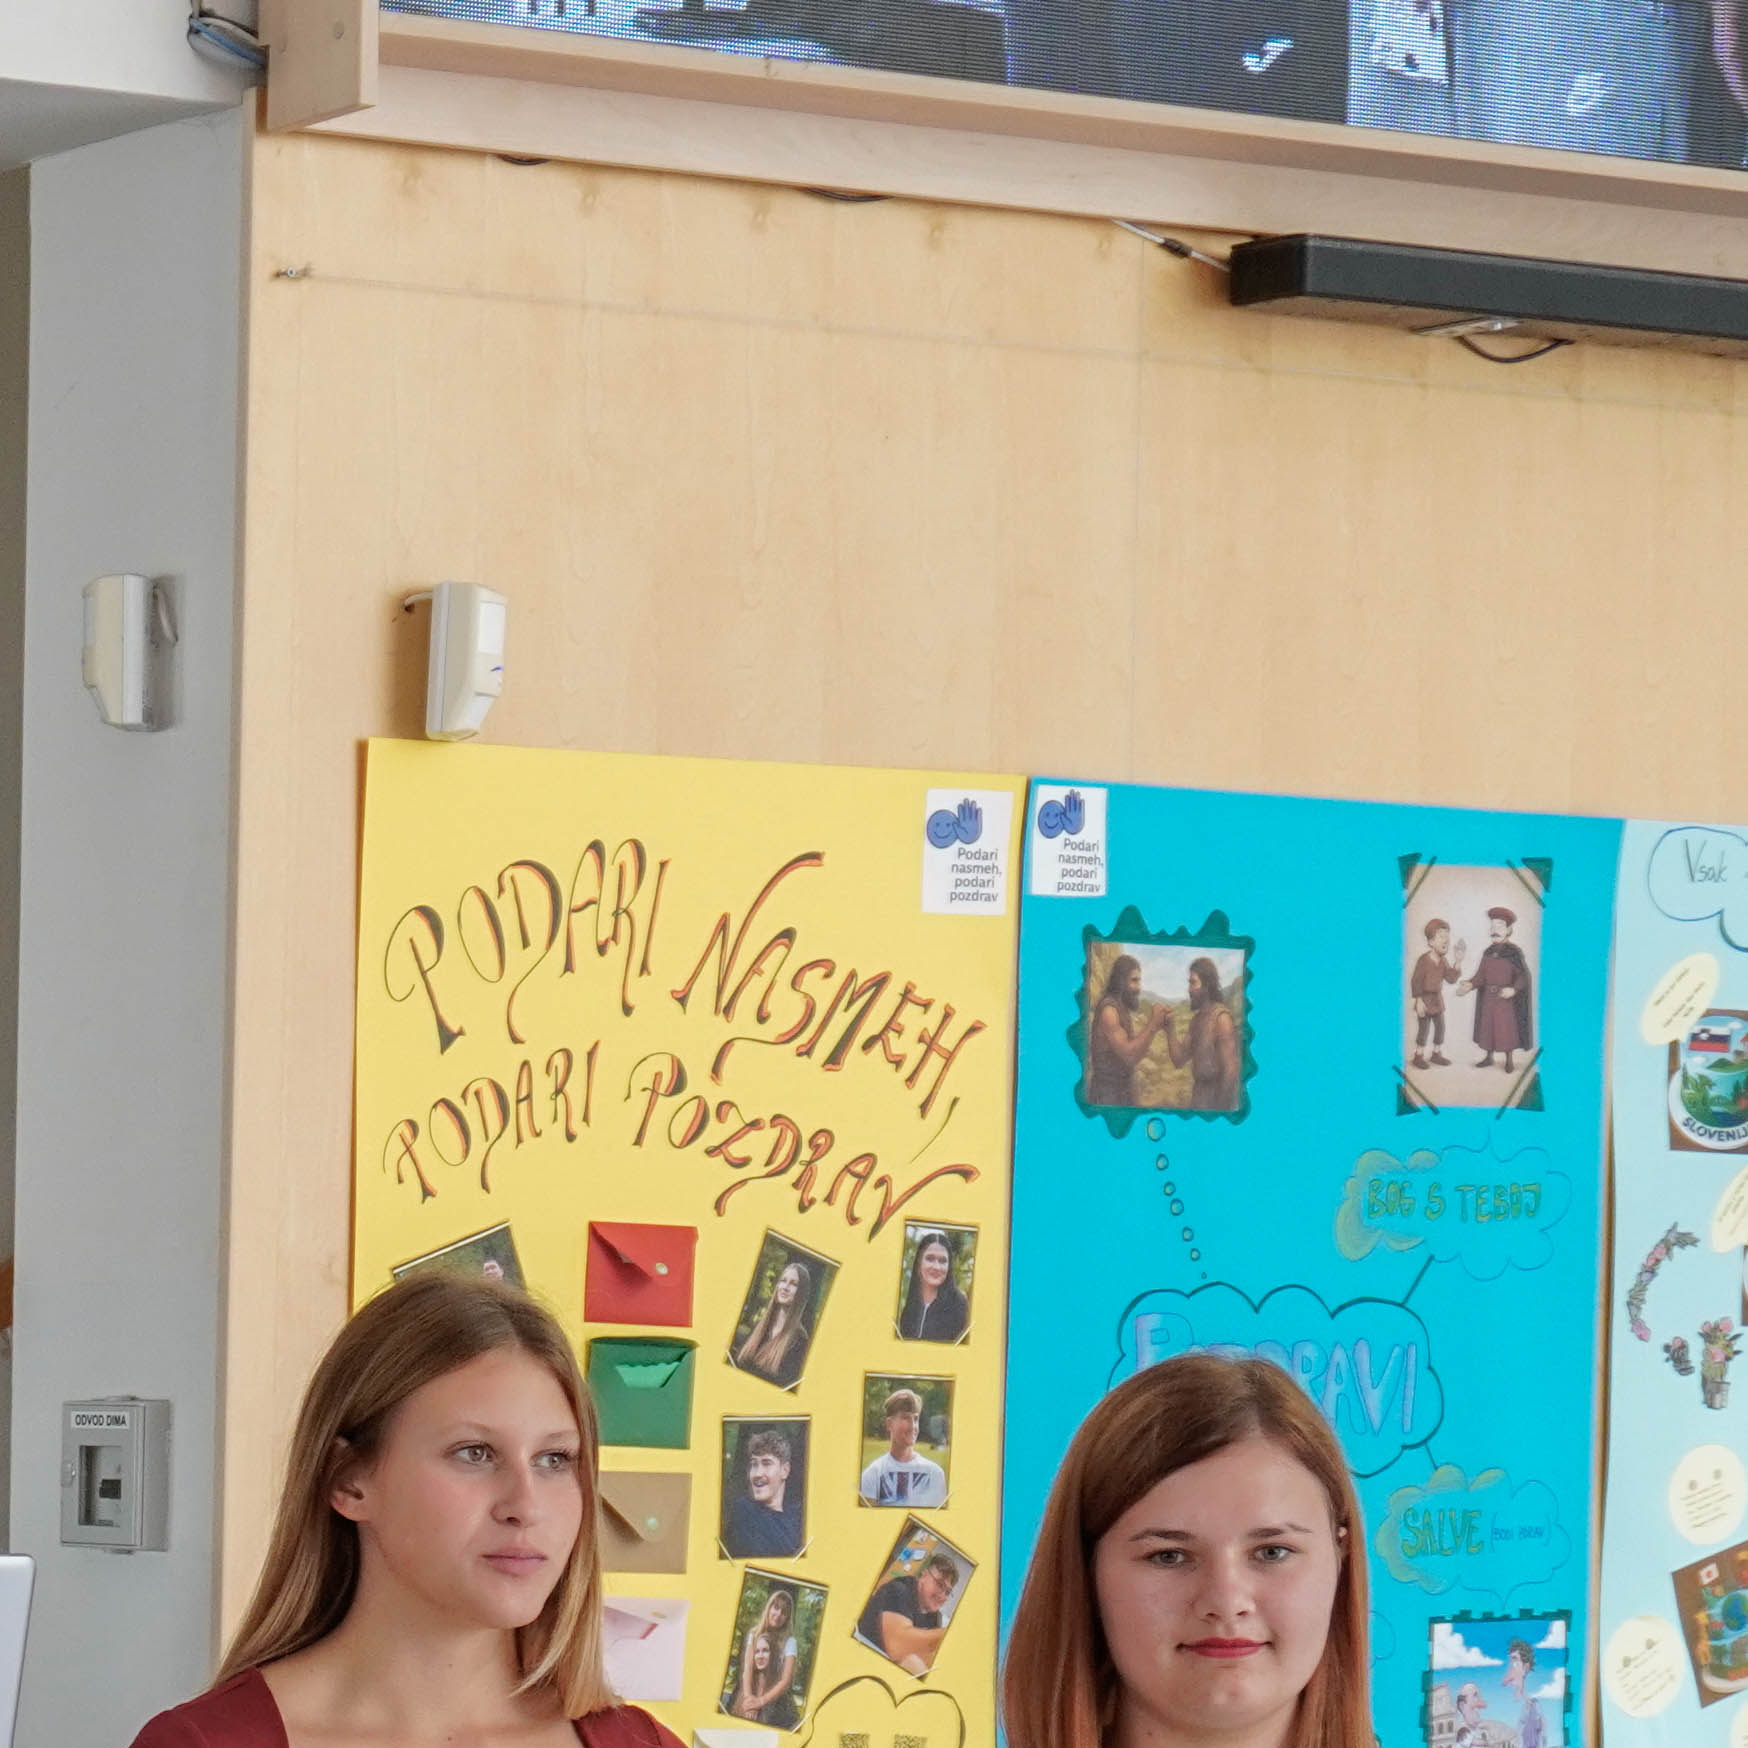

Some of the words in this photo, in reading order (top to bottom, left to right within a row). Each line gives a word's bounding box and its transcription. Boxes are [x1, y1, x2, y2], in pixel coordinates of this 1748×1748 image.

[1063, 837, 1100, 851] Podari
[958, 847, 998, 861] Podari
[1058, 852, 1104, 867] nasmeh,
[951, 863, 1002, 876] nasmeh,
[1061, 867, 1098, 881] podari
[955, 876, 995, 890] podari
[1057, 881, 1101, 893] pozdrav
[950, 890, 999, 904] pozdrav
[385, 838, 671, 1055] PODARI
[1682, 1116, 1748, 1142] SLOVENIJ
[382, 1040, 600, 1204] PODARI
[623, 1051, 982, 1243] POZDRAV
[75, 1414, 104, 1426] ODVOD
[106, 1414, 127, 1426] DIMA
[1401, 1507, 1485, 1558] SALVE
